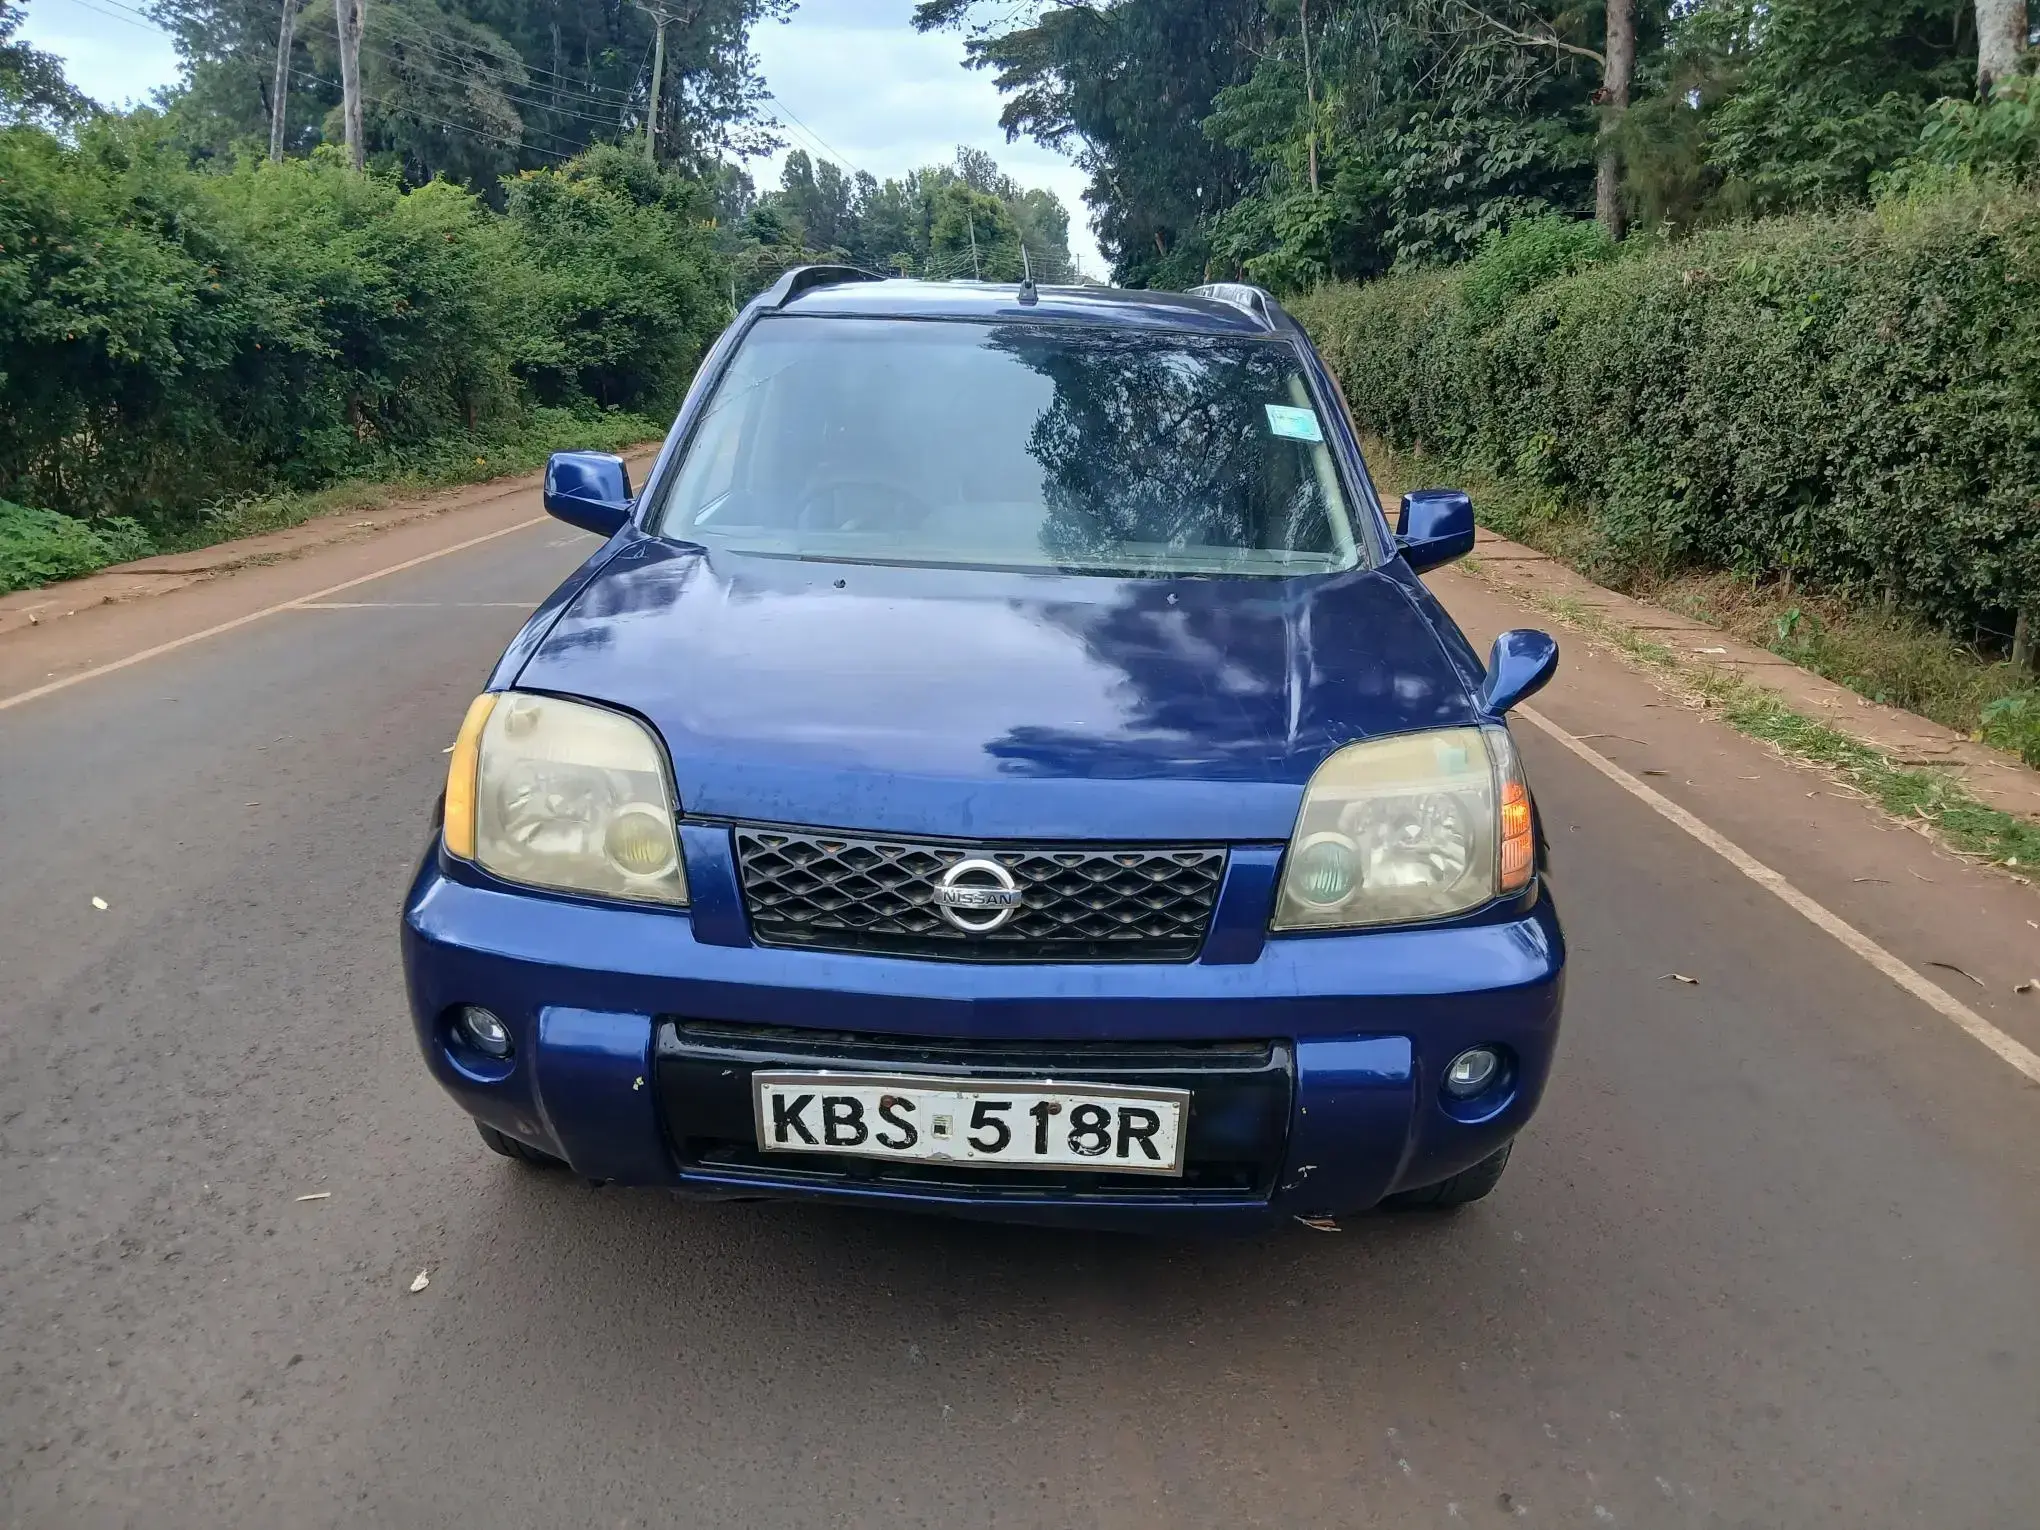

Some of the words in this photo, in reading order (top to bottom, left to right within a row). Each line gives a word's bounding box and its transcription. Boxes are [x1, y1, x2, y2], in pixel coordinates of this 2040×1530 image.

[943, 892, 1012, 905] NISSAN
[771, 1094, 918, 1150] KBS
[967, 1101, 1161, 1161] 518R
